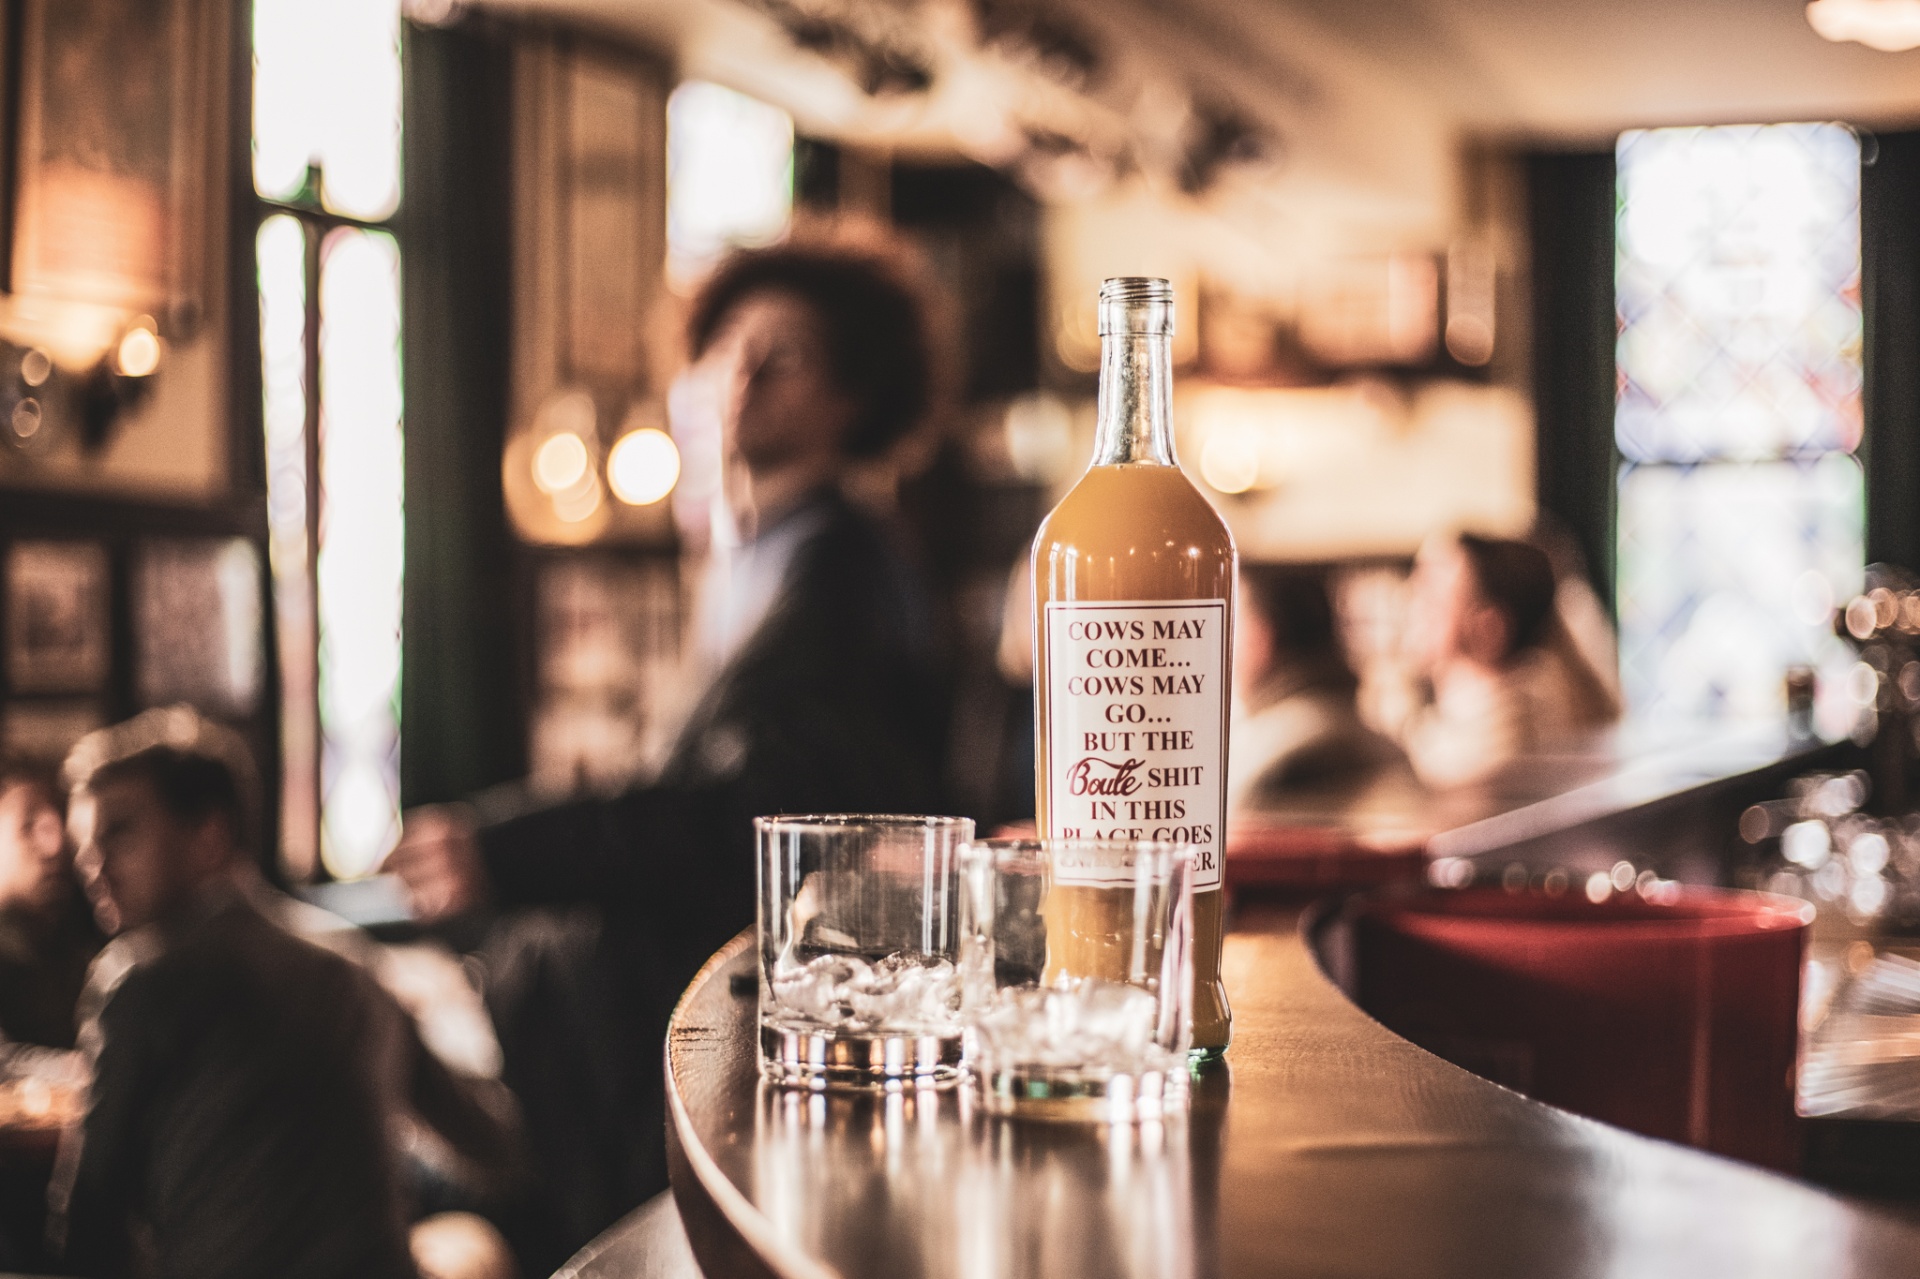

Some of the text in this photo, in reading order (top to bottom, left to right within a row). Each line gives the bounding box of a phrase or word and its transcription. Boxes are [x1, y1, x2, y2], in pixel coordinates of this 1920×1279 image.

[1068, 619, 1206, 641] COWS MAY
[1086, 648, 1191, 668] COME...
[1068, 674, 1205, 696] COWS MAY
[1105, 703, 1171, 724] GO...
[1084, 731, 1194, 751] BUT THE
[1147, 766, 1204, 788] SHIT
[1091, 799, 1186, 820] IN THIS
[1152, 824, 1212, 846] GOES
